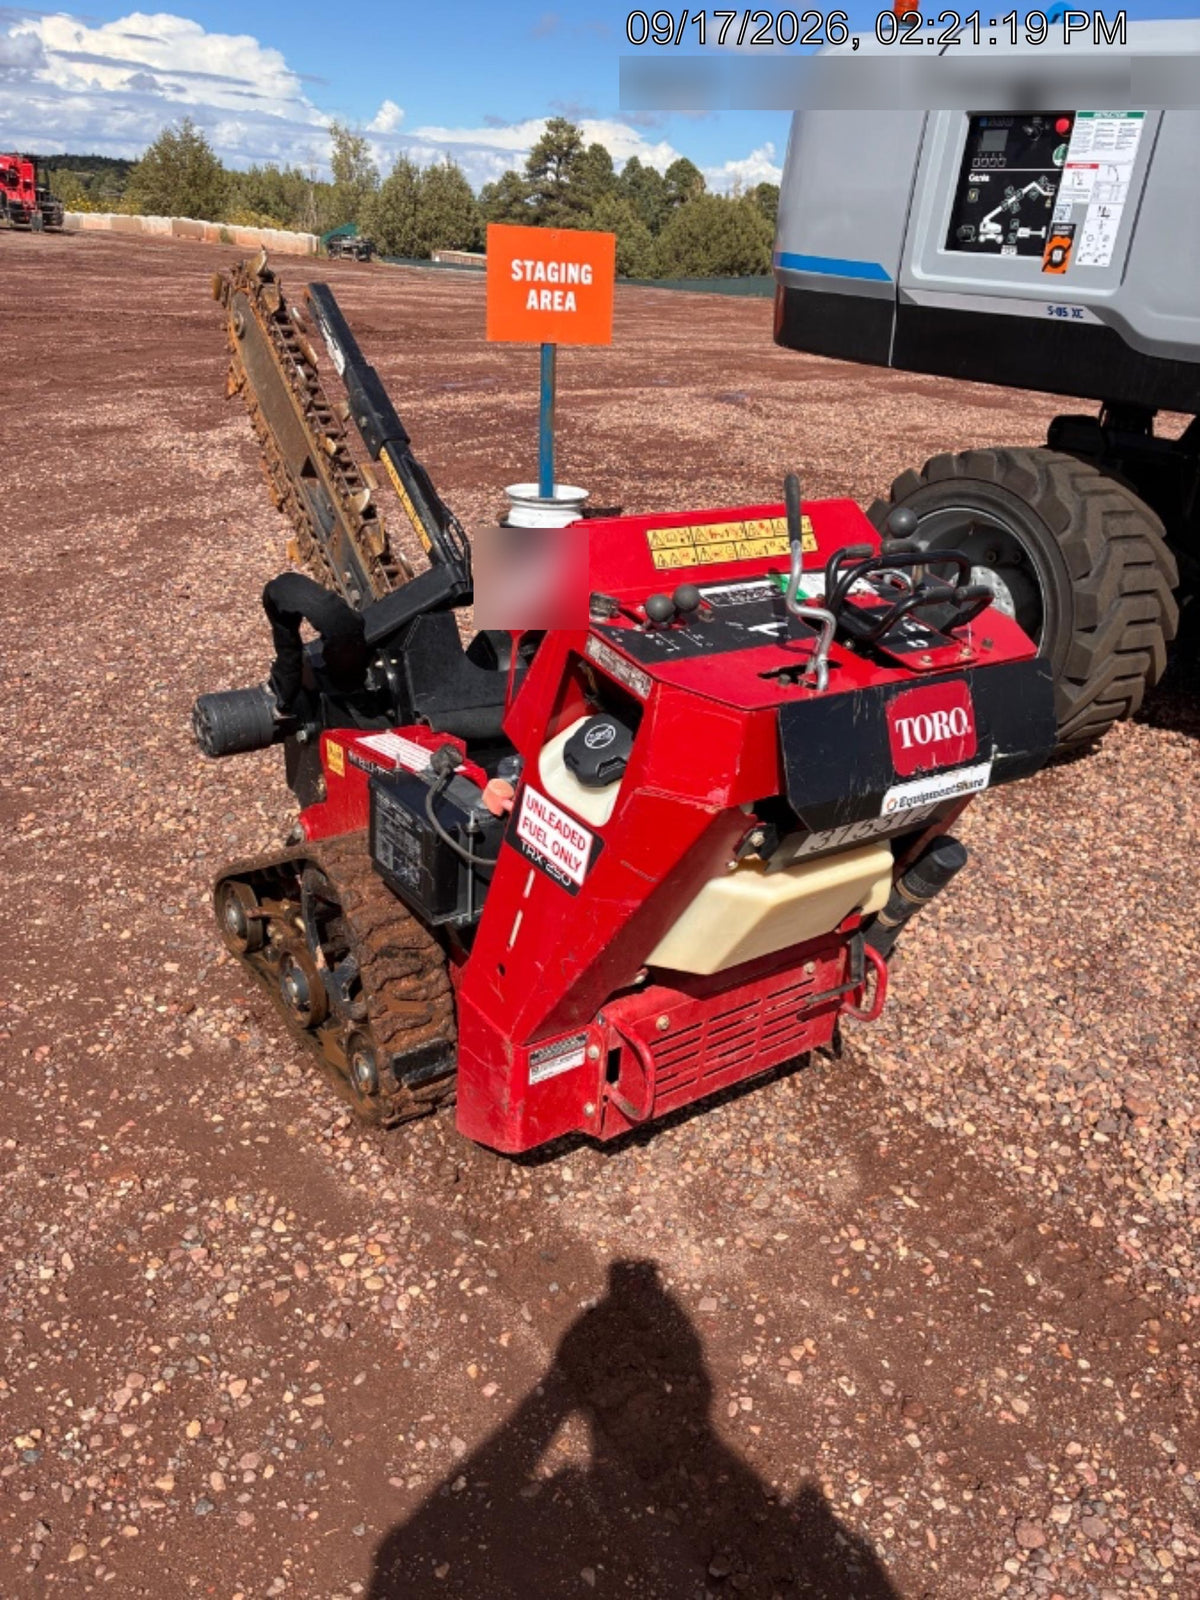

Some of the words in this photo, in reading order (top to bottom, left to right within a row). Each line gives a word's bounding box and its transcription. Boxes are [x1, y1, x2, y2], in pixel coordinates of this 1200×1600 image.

[511, 259, 593, 285] STAGING
[526, 289, 577, 312] AREA
[895, 707, 969, 749] TORO
[899, 778, 984, 808] EquipmentShare
[526, 794, 586, 851] UNLEADED
[521, 816, 549, 849] FUEL
[552, 840, 582, 872] ONLY
